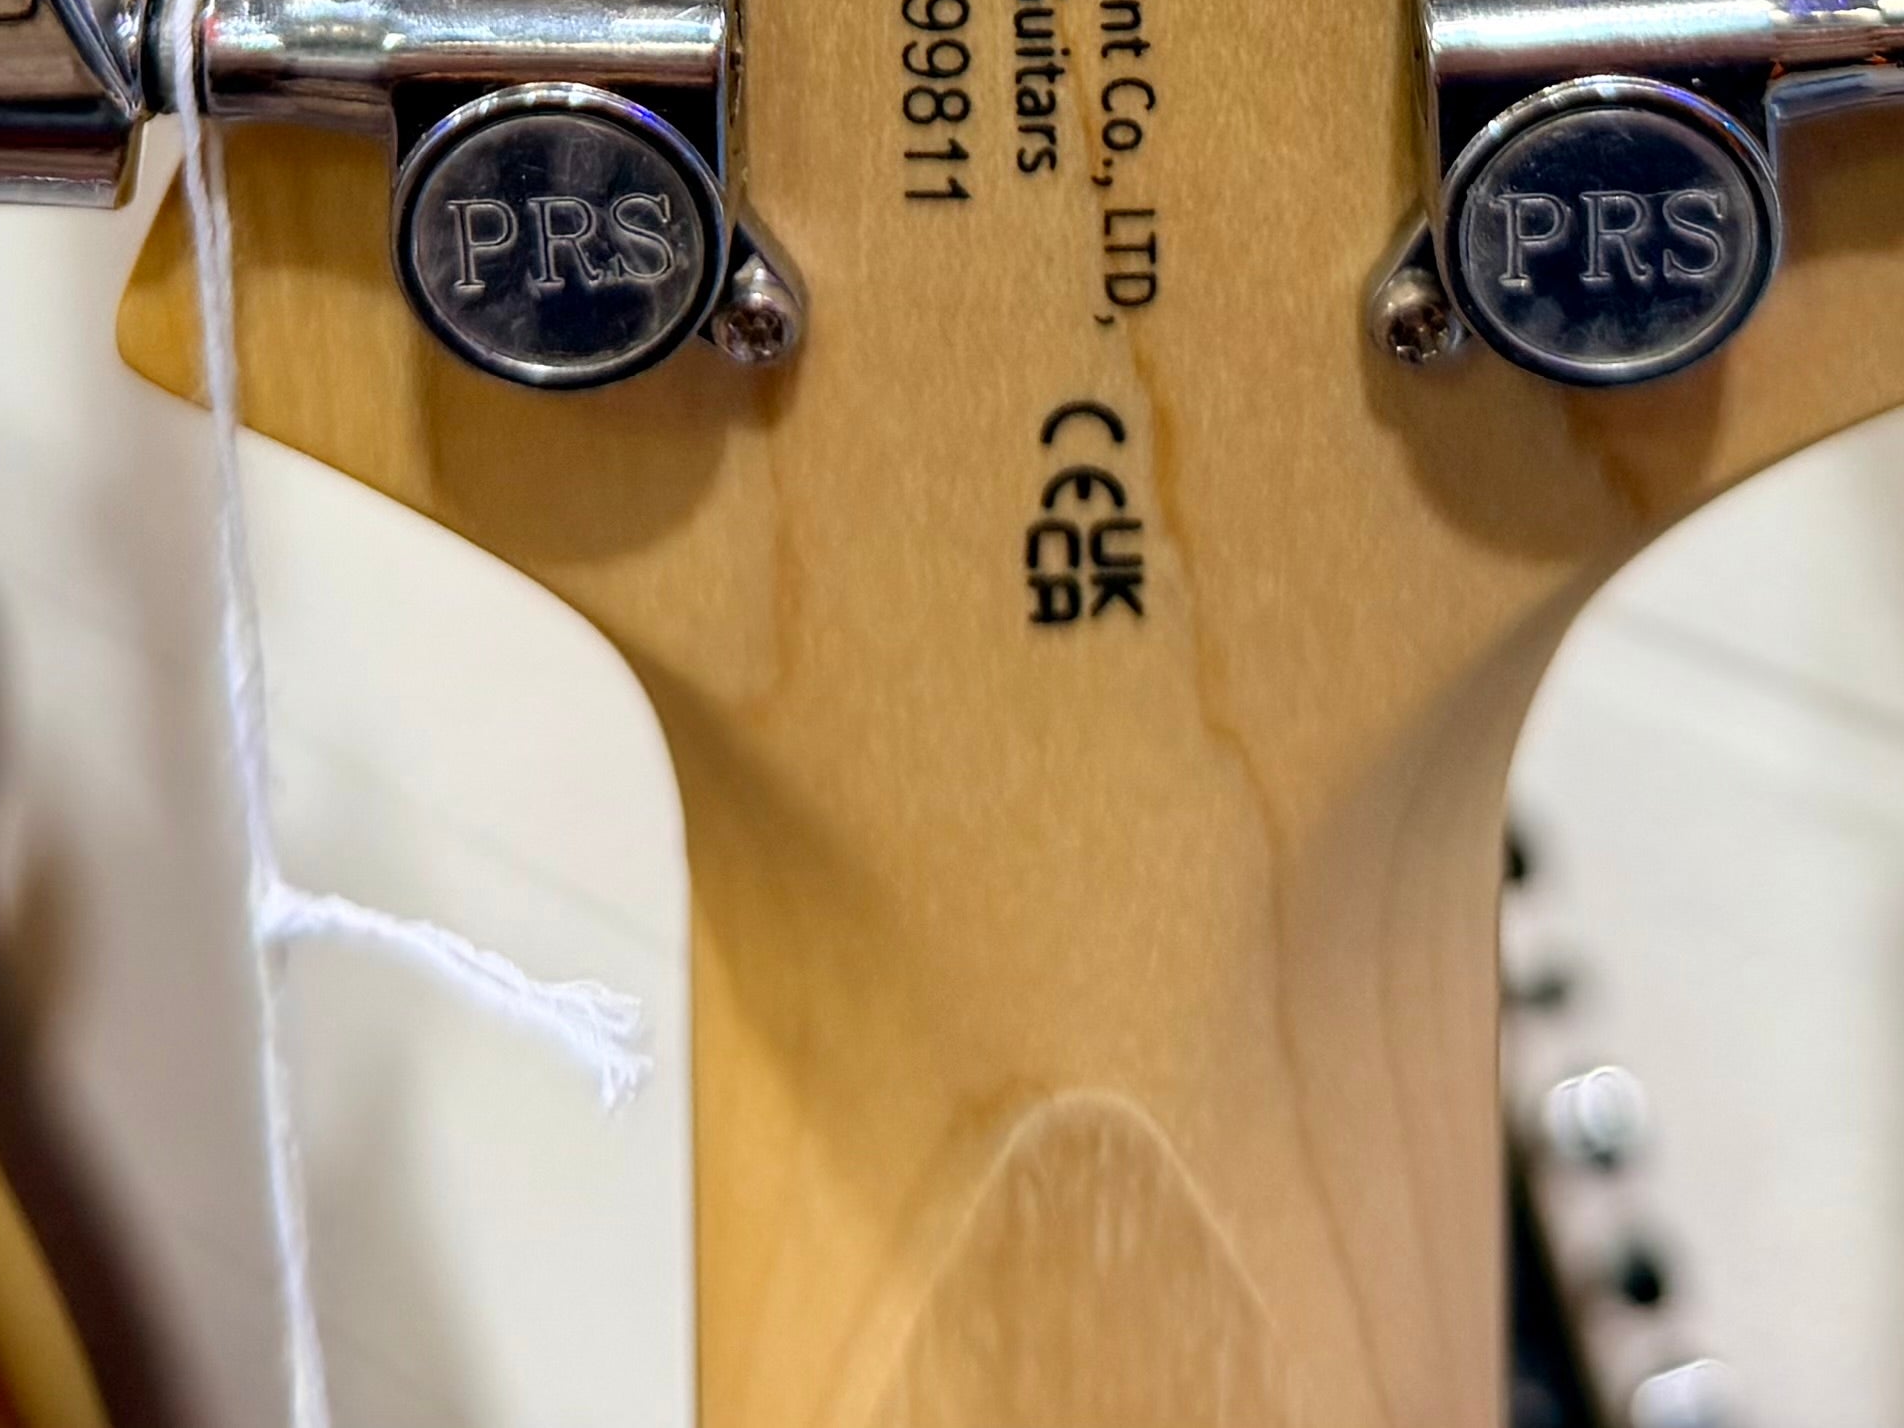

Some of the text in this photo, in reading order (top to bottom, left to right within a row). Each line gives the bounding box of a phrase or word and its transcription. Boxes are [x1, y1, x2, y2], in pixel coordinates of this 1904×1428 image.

[1090, 77, 1157, 190] Co.,
[446, 192, 674, 292] PRS
[1094, 208, 1158, 327] LTD,
[1496, 189, 1730, 286] PRS
[1025, 518, 1081, 624] CA
[1089, 516, 1144, 618] UK
